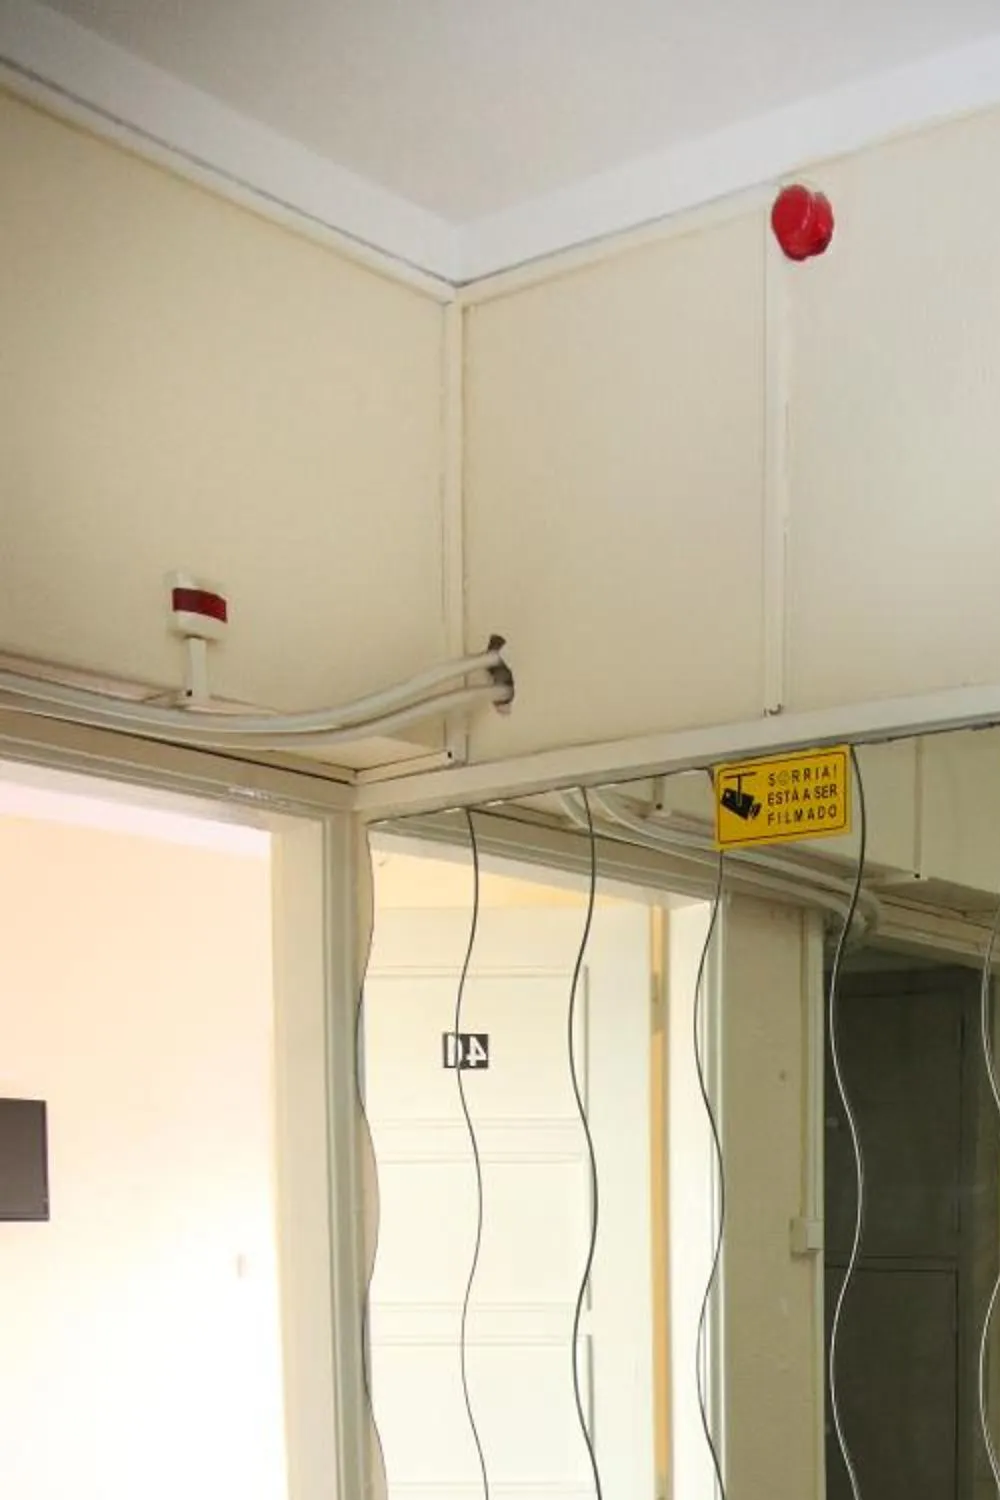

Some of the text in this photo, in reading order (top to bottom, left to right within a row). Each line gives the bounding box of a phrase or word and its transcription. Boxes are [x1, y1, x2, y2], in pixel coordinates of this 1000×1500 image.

[803, 788, 811, 801] A
[815, 783, 837, 799] SER
[767, 803, 837, 826] FILMADO
